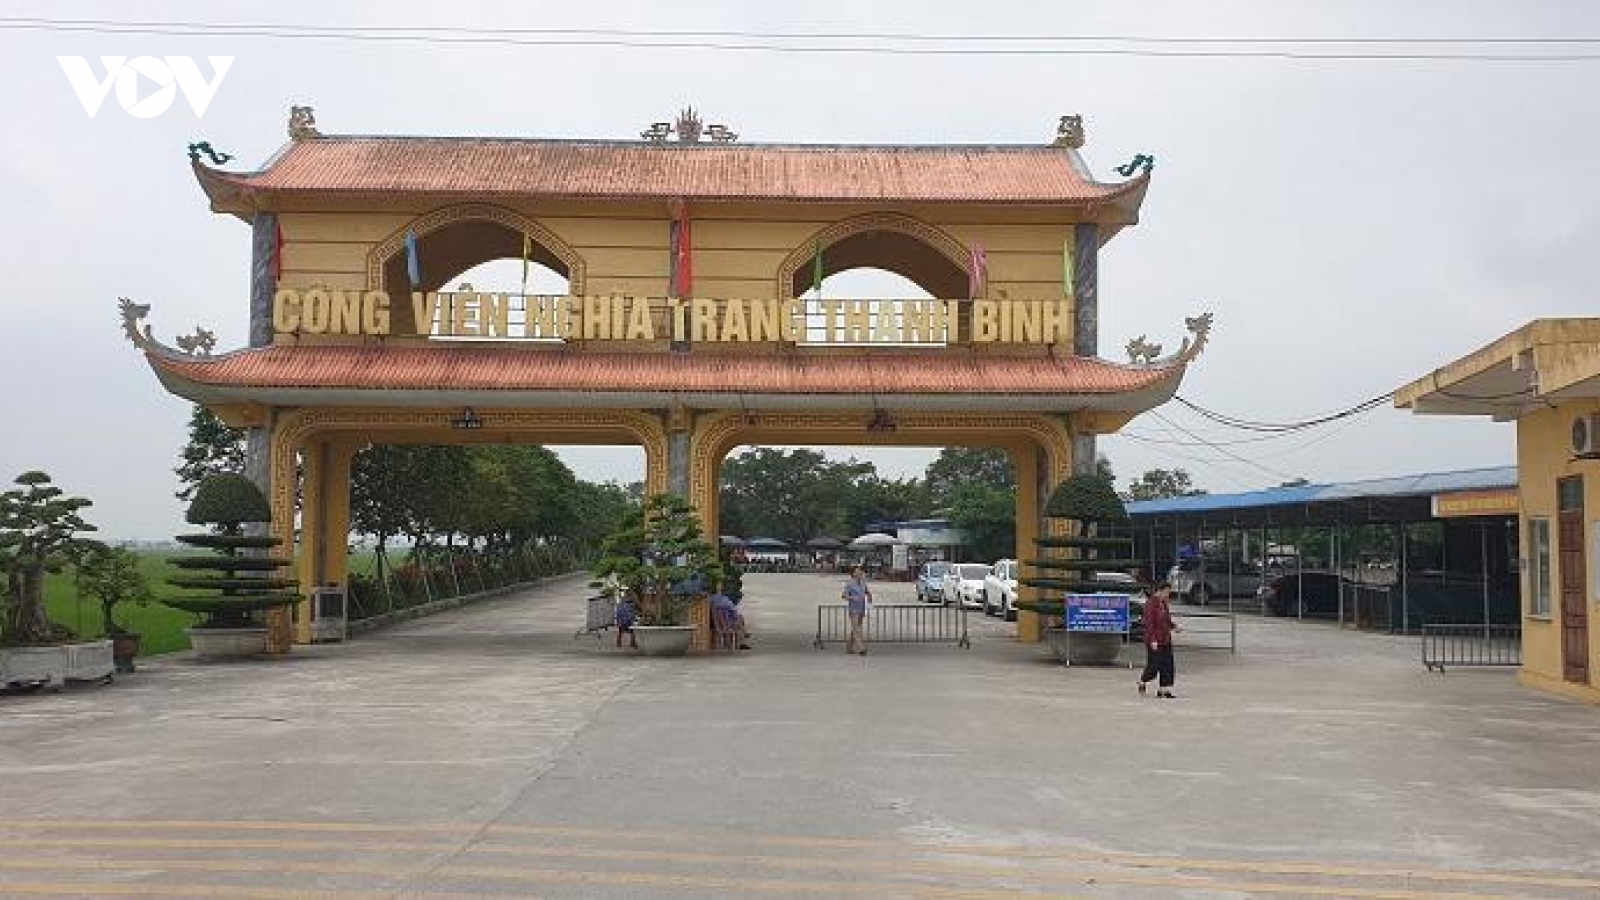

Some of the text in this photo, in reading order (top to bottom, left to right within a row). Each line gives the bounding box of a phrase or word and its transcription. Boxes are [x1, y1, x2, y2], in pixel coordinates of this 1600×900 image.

[273, 284, 390, 334] CÔNG
[412, 283, 508, 335] VIÊN
[667, 297, 807, 342] TRANG
[820, 299, 959, 343] THANH
